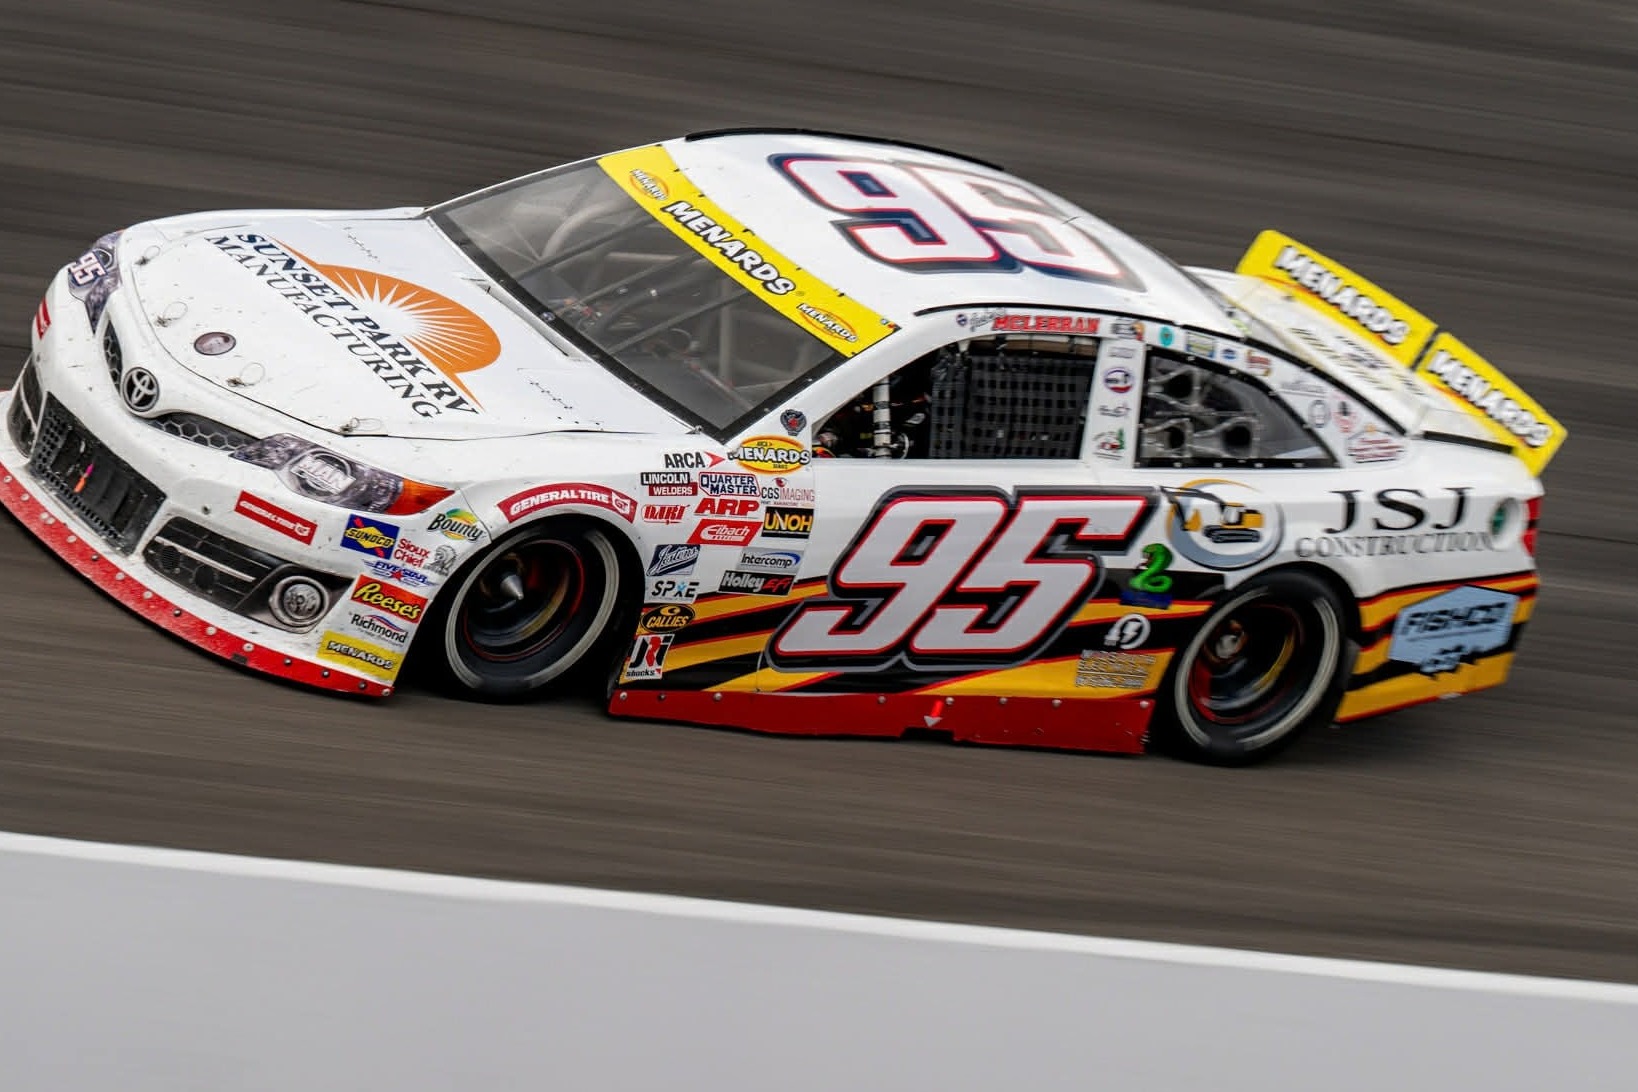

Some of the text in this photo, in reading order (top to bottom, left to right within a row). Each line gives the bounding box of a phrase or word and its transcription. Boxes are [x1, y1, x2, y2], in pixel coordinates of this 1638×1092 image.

[767, 153, 1147, 292] 95
[661, 200, 796, 295] MENARDS
[69, 251, 106, 285] 95
[1273, 245, 1410, 345] MENARDS
[205, 235, 442, 418] MANUFACTURING
[236, 233, 480, 415] SUNSET PARK RV
[797, 303, 858, 342] MENARDS
[1427, 349, 1552, 447] MENARDS
[664, 452, 706, 468] ARCA
[728, 447, 811, 465] MENARDS
[643, 473, 689, 485] LINCOLN
[700, 475, 755, 488] QUARTER
[710, 484, 757, 496] MASTER
[653, 486, 692, 496] WELDERS
[510, 490, 575, 516] GENERAL
[577, 489, 609, 503] TIRE
[695, 498, 760, 516] ARP
[1324, 487, 1476, 534] JSJ
[427, 513, 484, 542] Bounty
[765, 510, 813, 532] UNOH
[346, 528, 395, 548] SUNOCO
[701, 524, 751, 541] Eibach
[398, 538, 430, 557] Sioux
[1294, 532, 1495, 558] CONSTRUCTION
[394, 549, 425, 567] Chief
[741, 553, 793, 569] Intercomp
[722, 573, 764, 592] Holley
[768, 487, 1157, 667] 95
[351, 614, 409, 643] Richmond
[646, 615, 689, 628] CALLIES
[327, 640, 395, 669] MENARDS
[626, 669, 656, 678] shocks
